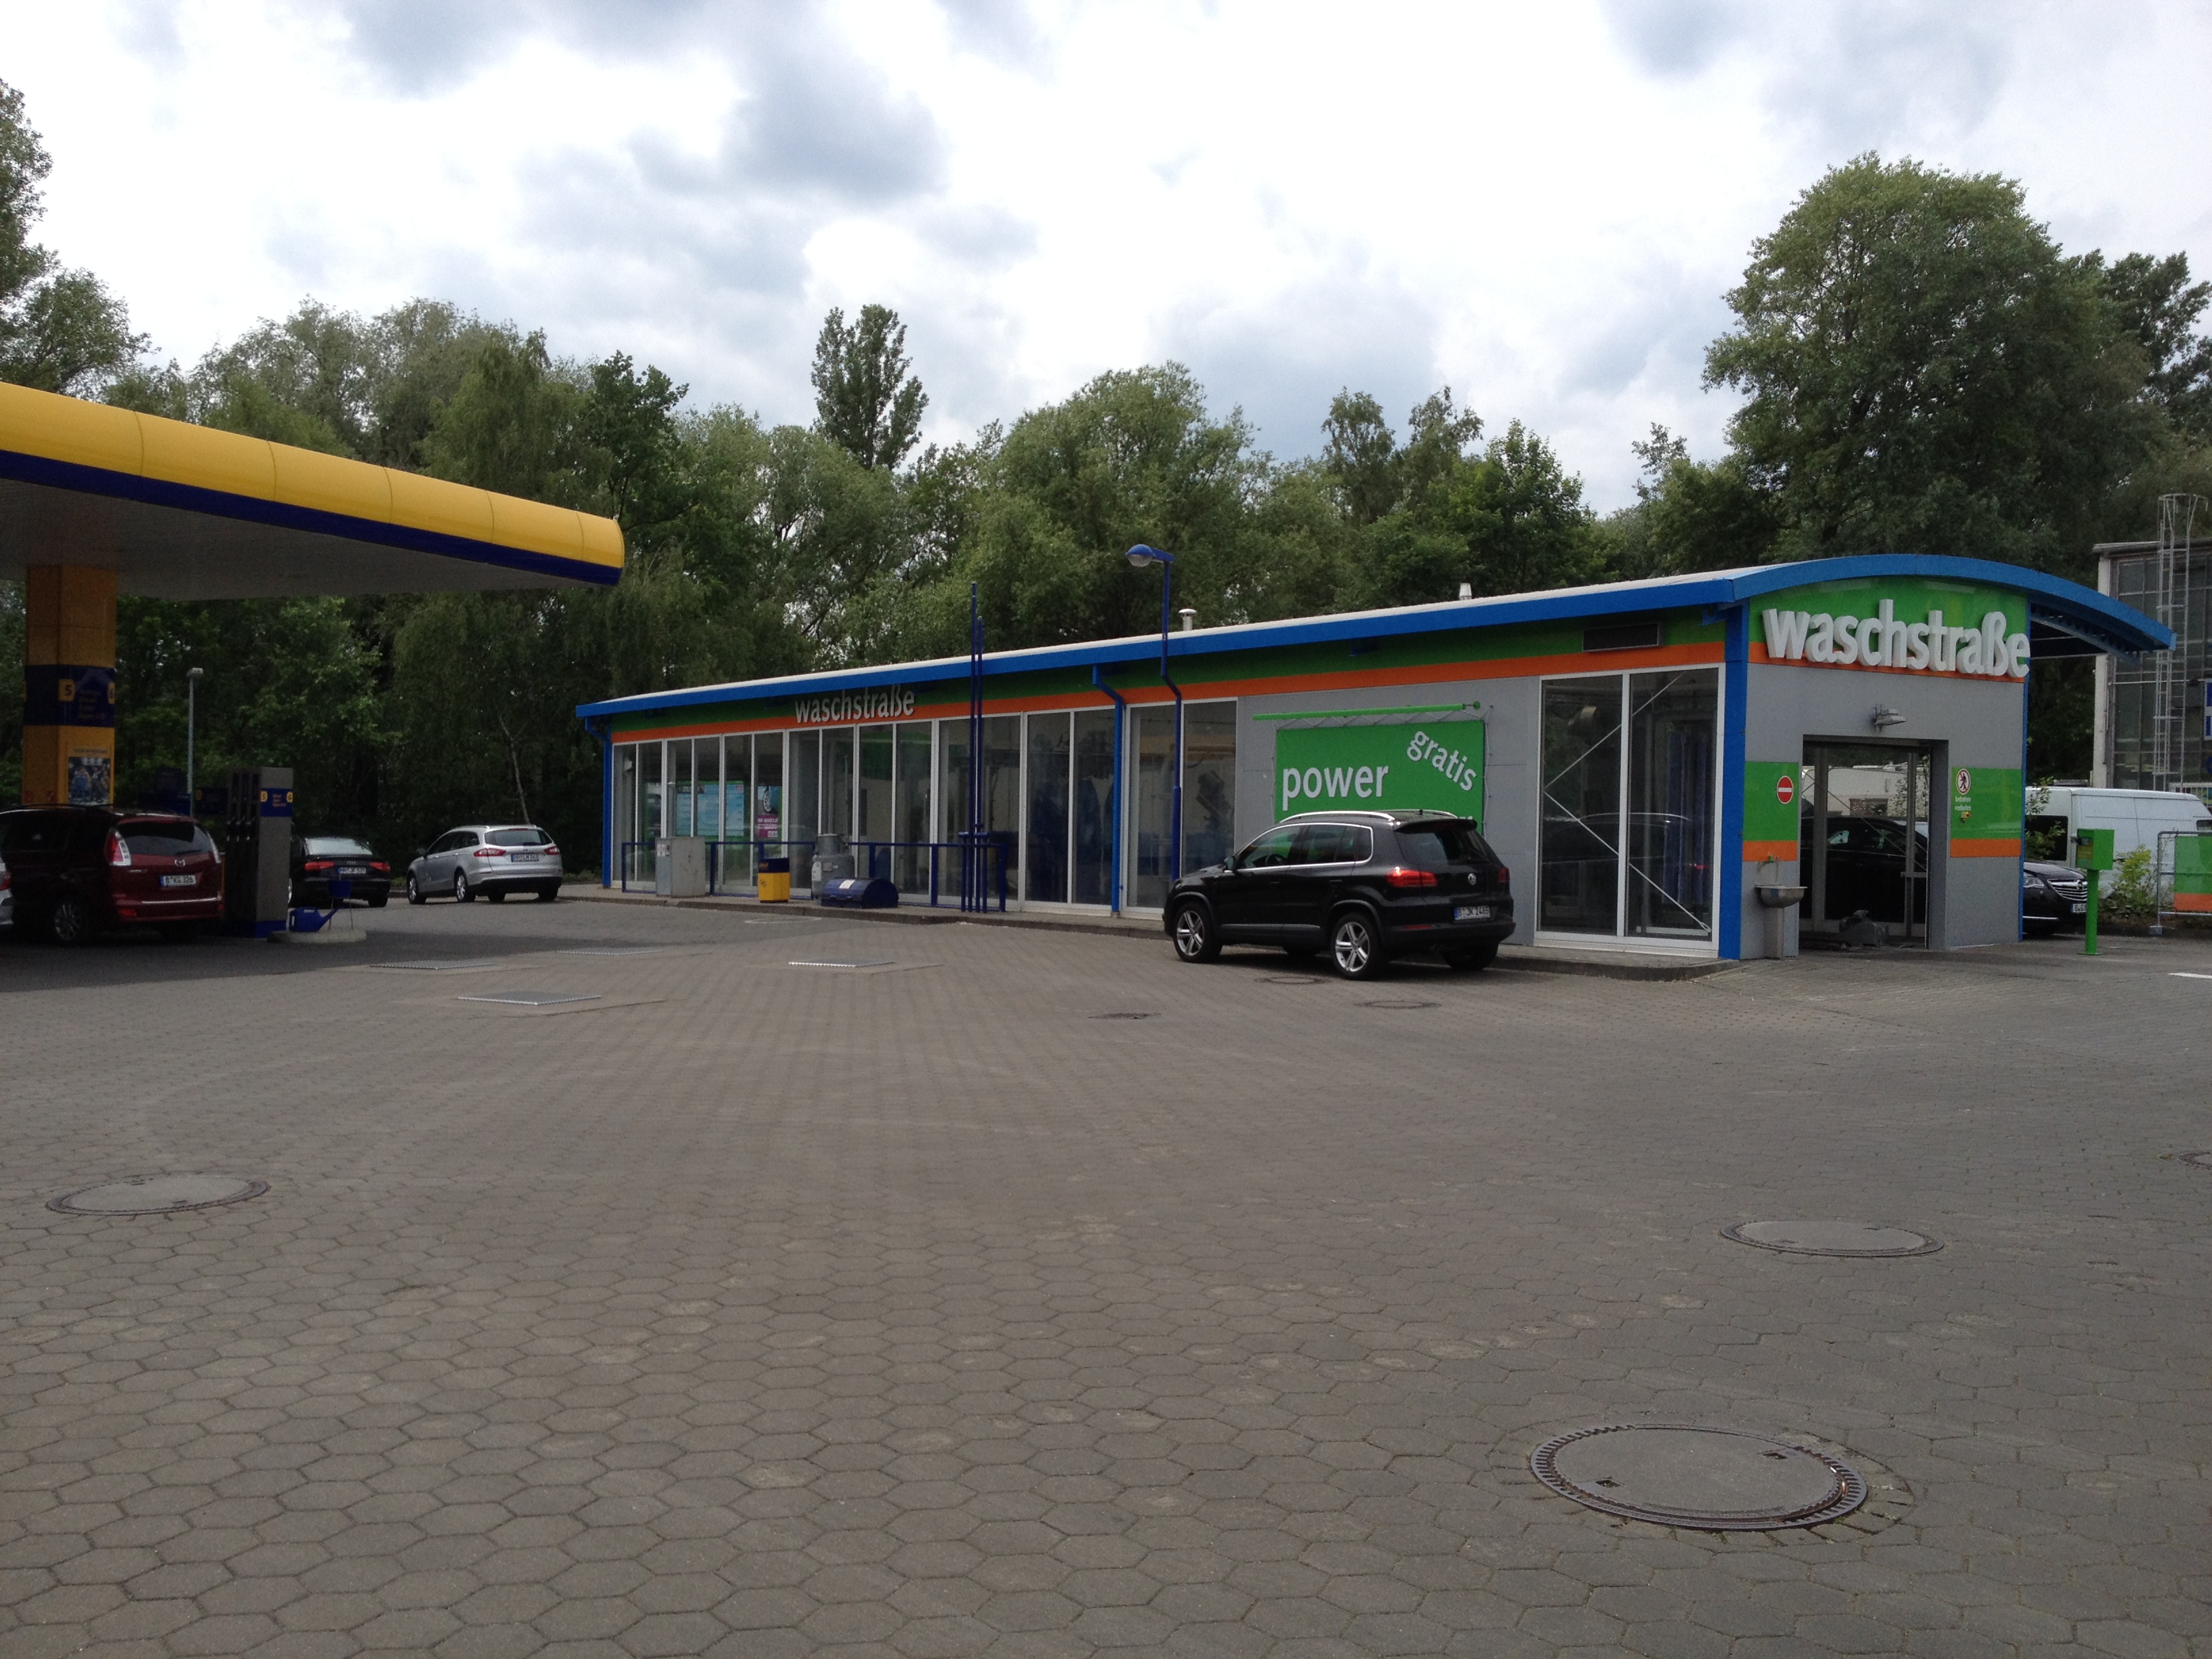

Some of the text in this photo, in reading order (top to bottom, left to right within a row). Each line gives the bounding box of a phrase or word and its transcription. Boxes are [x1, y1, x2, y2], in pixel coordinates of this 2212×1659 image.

[1763, 599, 2030, 678] waschstraße
[795, 684, 915, 724] waschstraße
[1406, 731, 1477, 792] gratis
[1282, 766, 1389, 811] power
